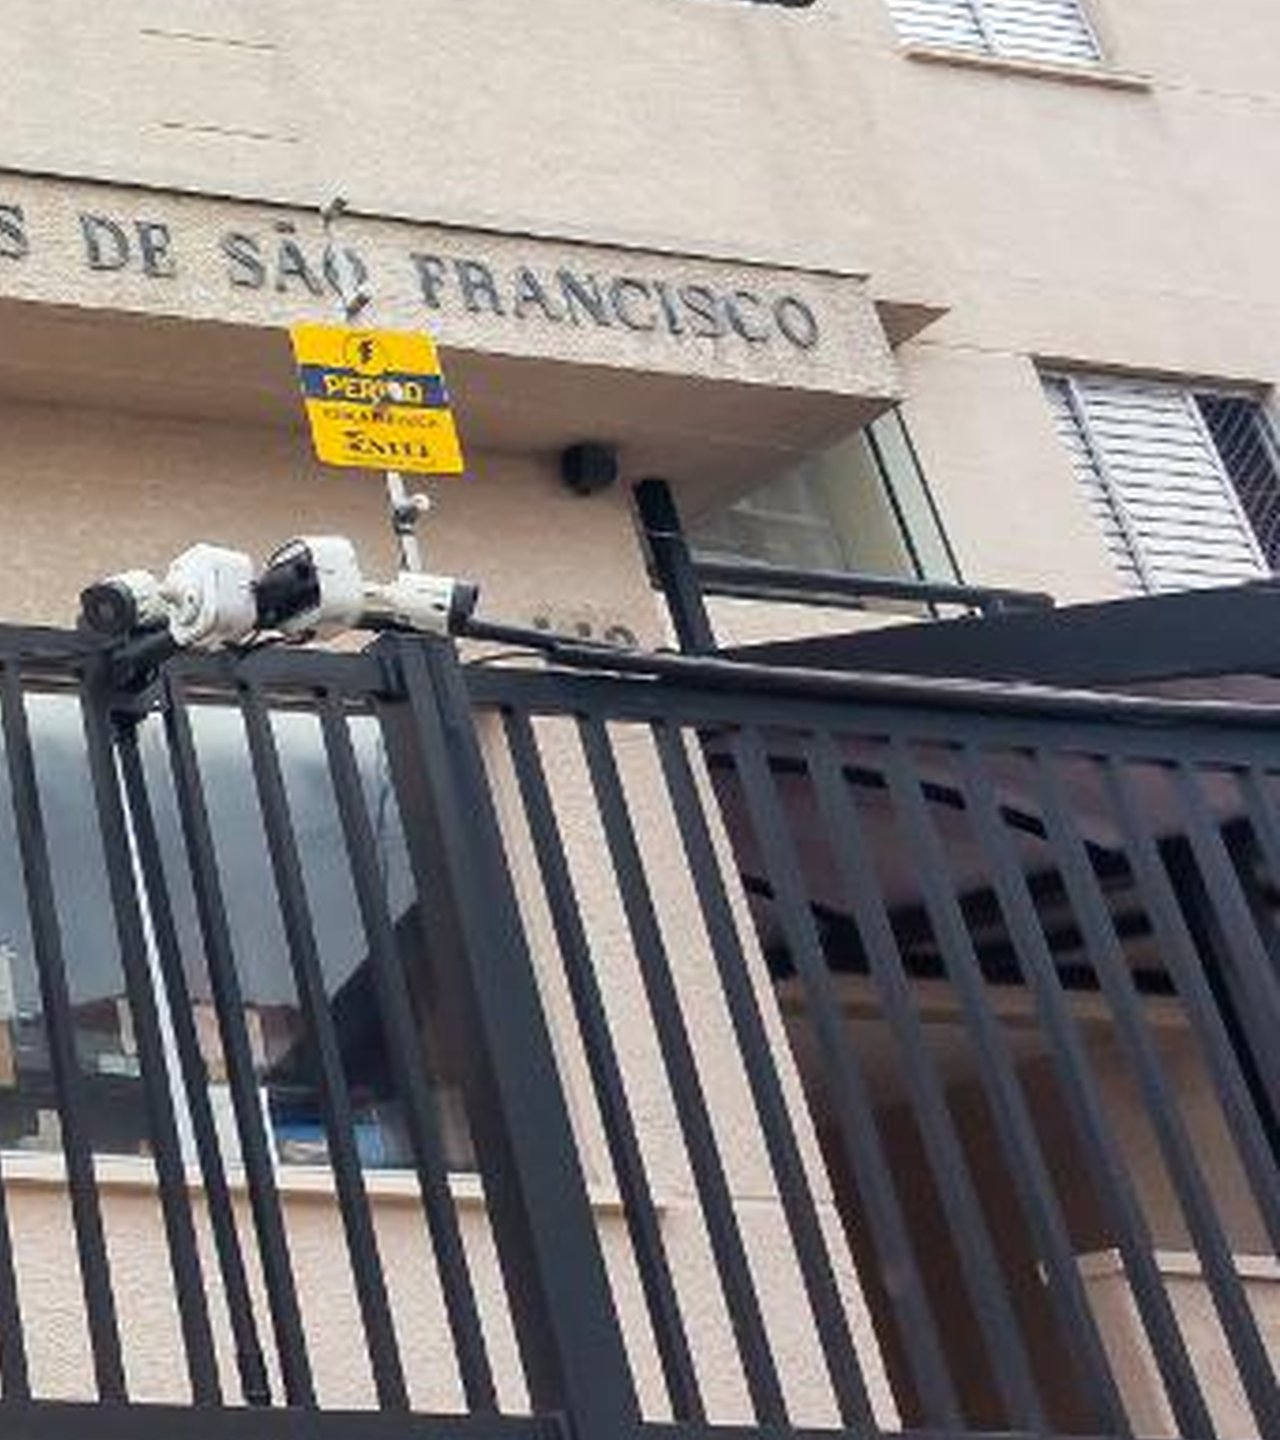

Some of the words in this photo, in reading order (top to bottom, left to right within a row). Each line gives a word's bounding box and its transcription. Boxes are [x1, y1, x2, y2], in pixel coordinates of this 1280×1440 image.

[78, 215, 175, 277] DE
[220, 221, 368, 301] SÃO
[409, 251, 821, 351] FRANCISCO
